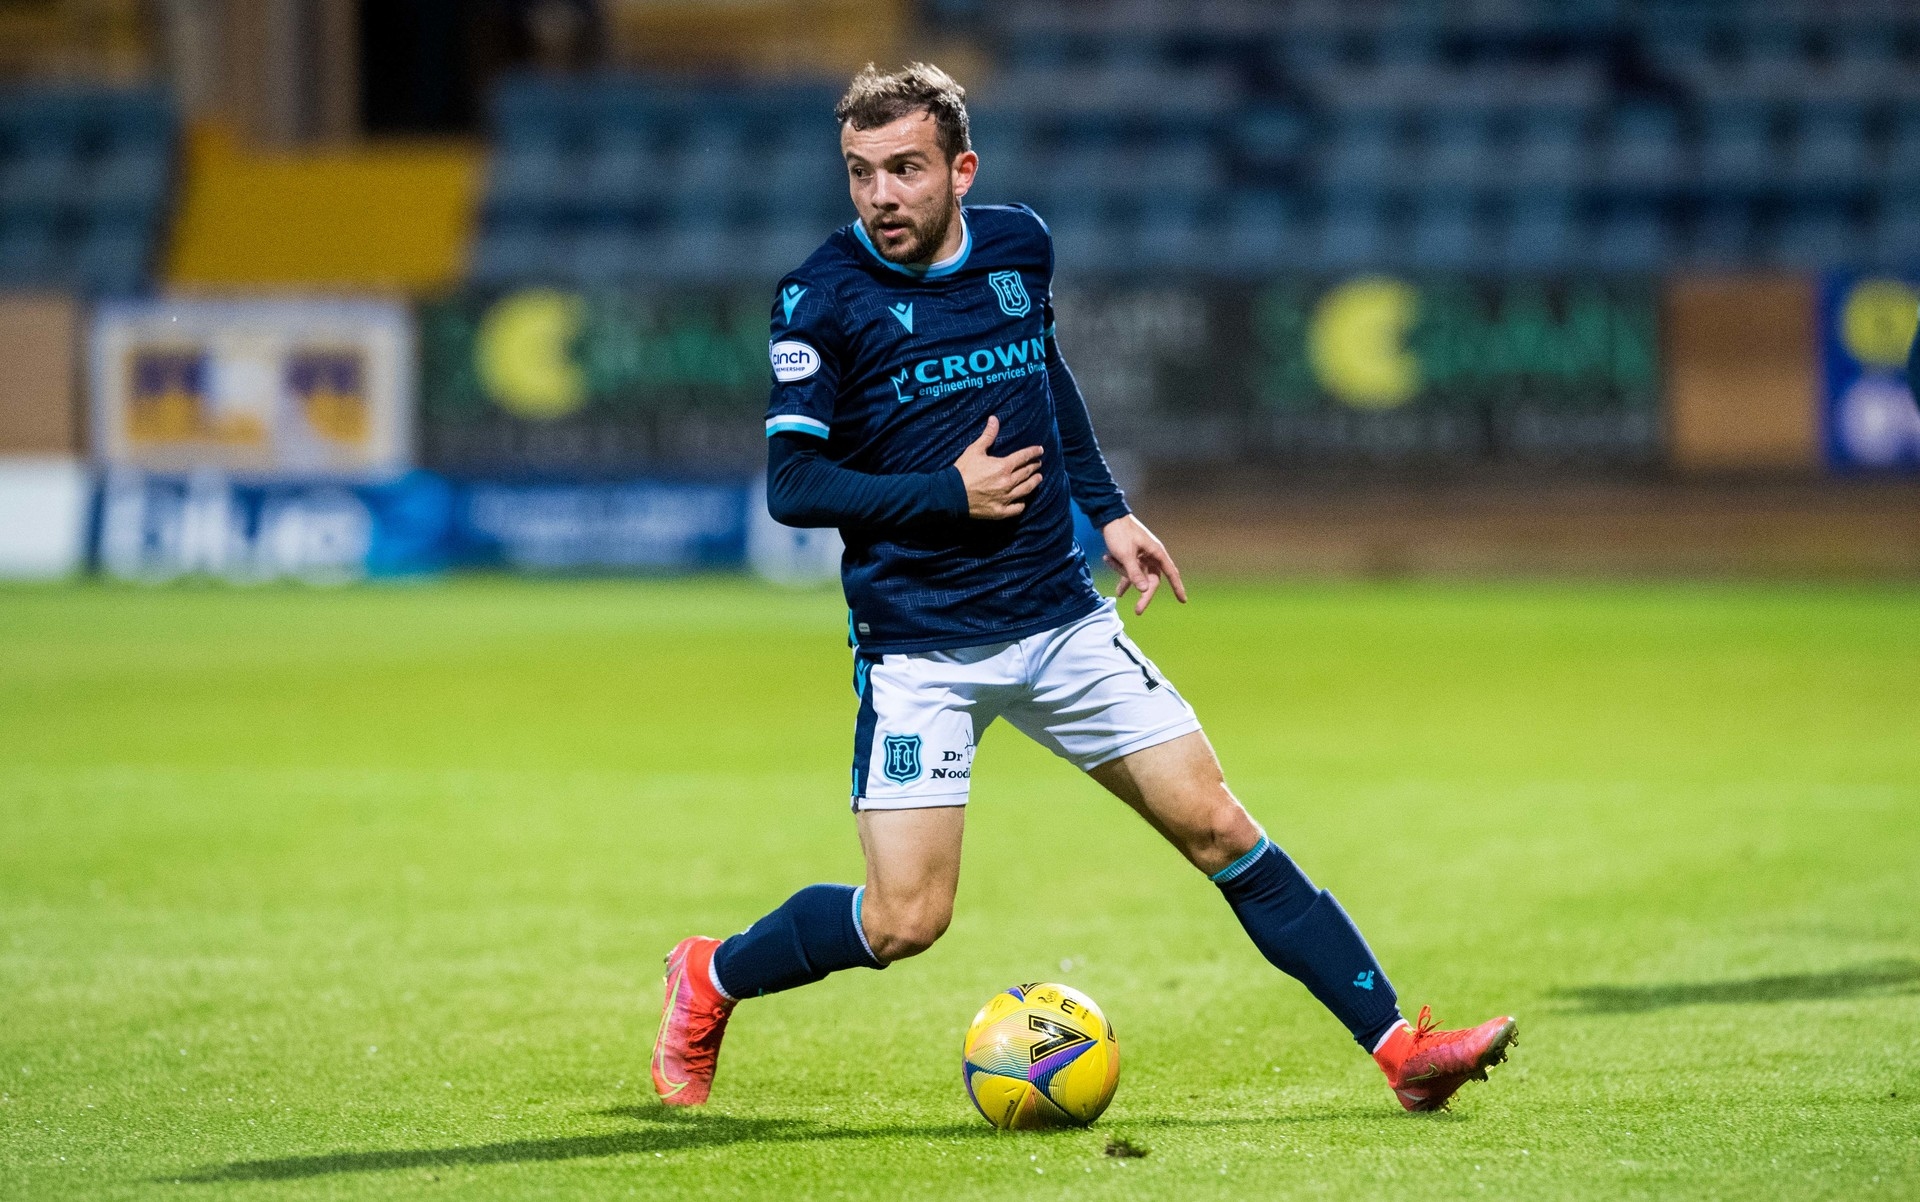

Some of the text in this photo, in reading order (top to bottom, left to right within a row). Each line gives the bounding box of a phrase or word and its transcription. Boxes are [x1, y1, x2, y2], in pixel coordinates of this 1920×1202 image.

[914, 336, 1046, 384] CROWN
[919, 376, 984, 397] engineering
[986, 367, 1026, 384] services
[941, 750, 963, 762] Dr
